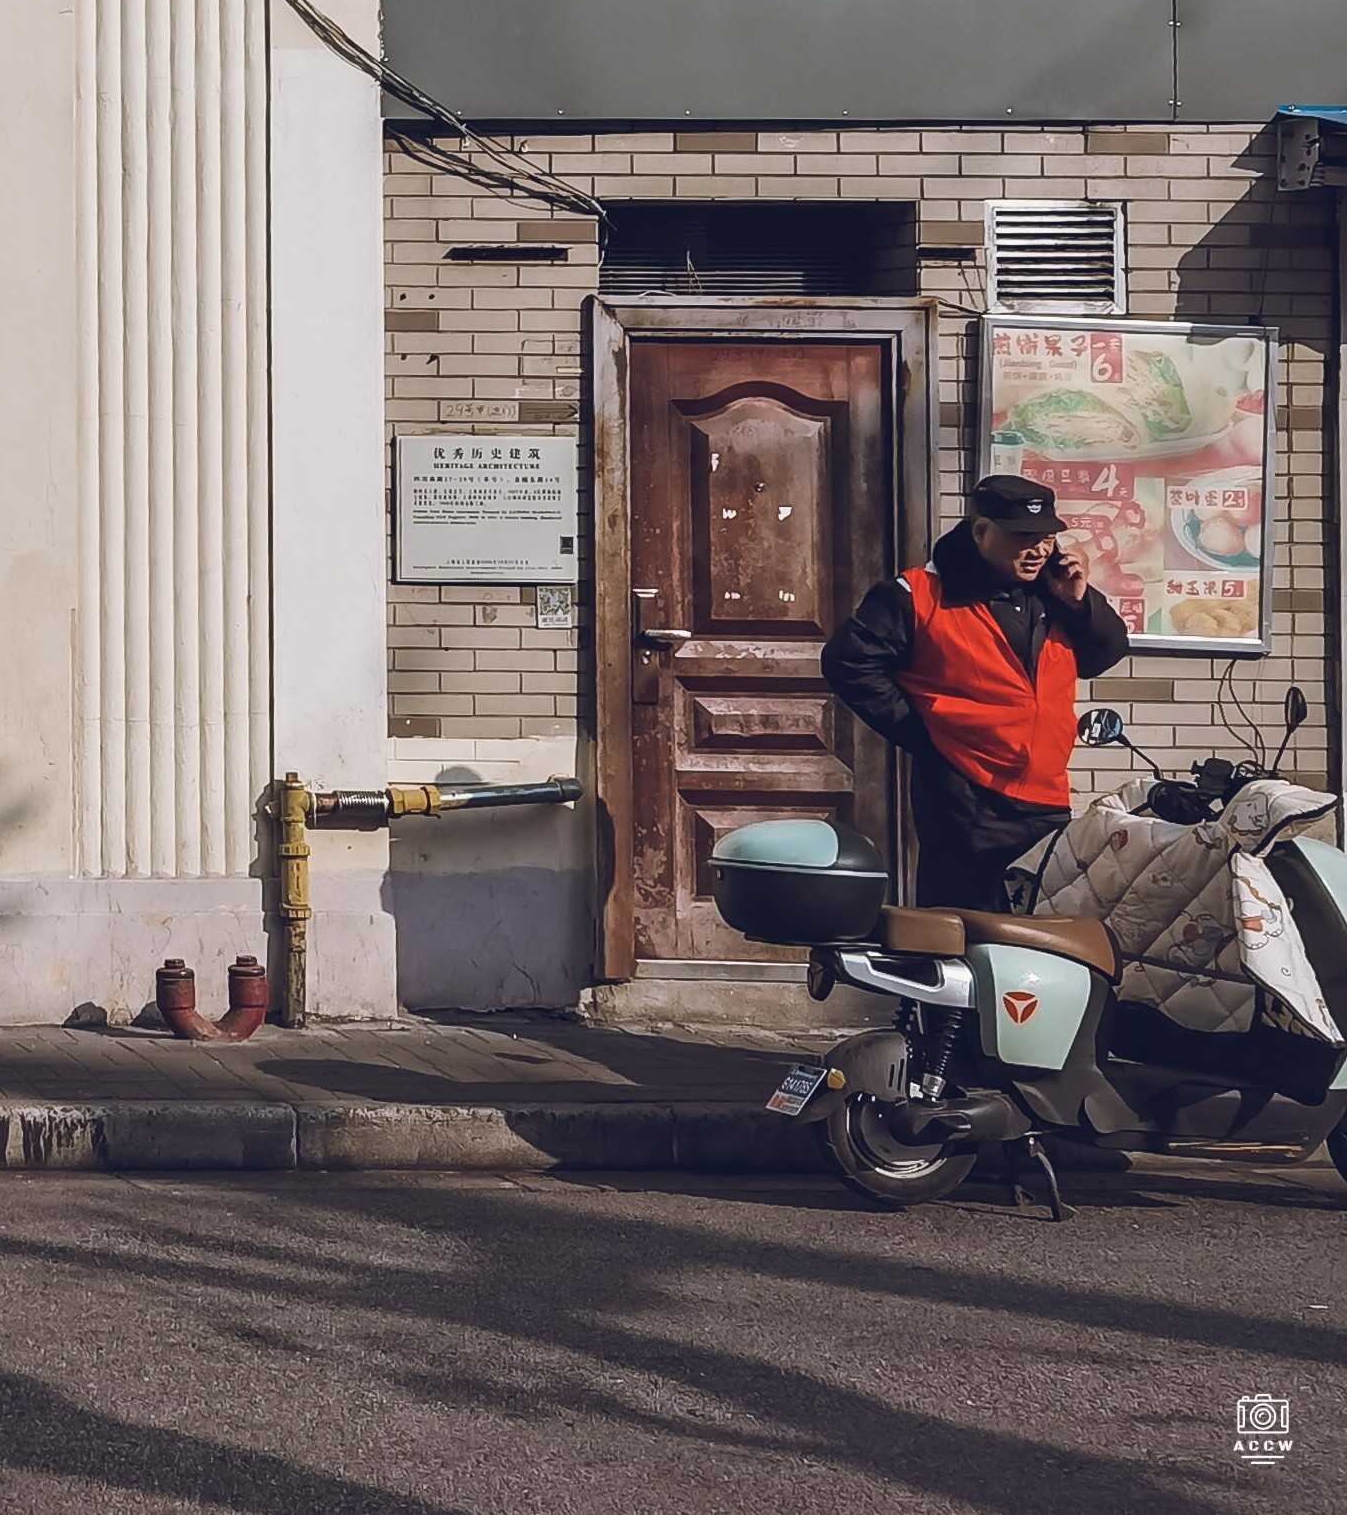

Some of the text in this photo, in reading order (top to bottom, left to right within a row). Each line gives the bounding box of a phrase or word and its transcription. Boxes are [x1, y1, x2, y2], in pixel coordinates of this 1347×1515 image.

[1092, 352, 1114, 382] 6
[433, 447, 541, 461] 优秀历史建筑
